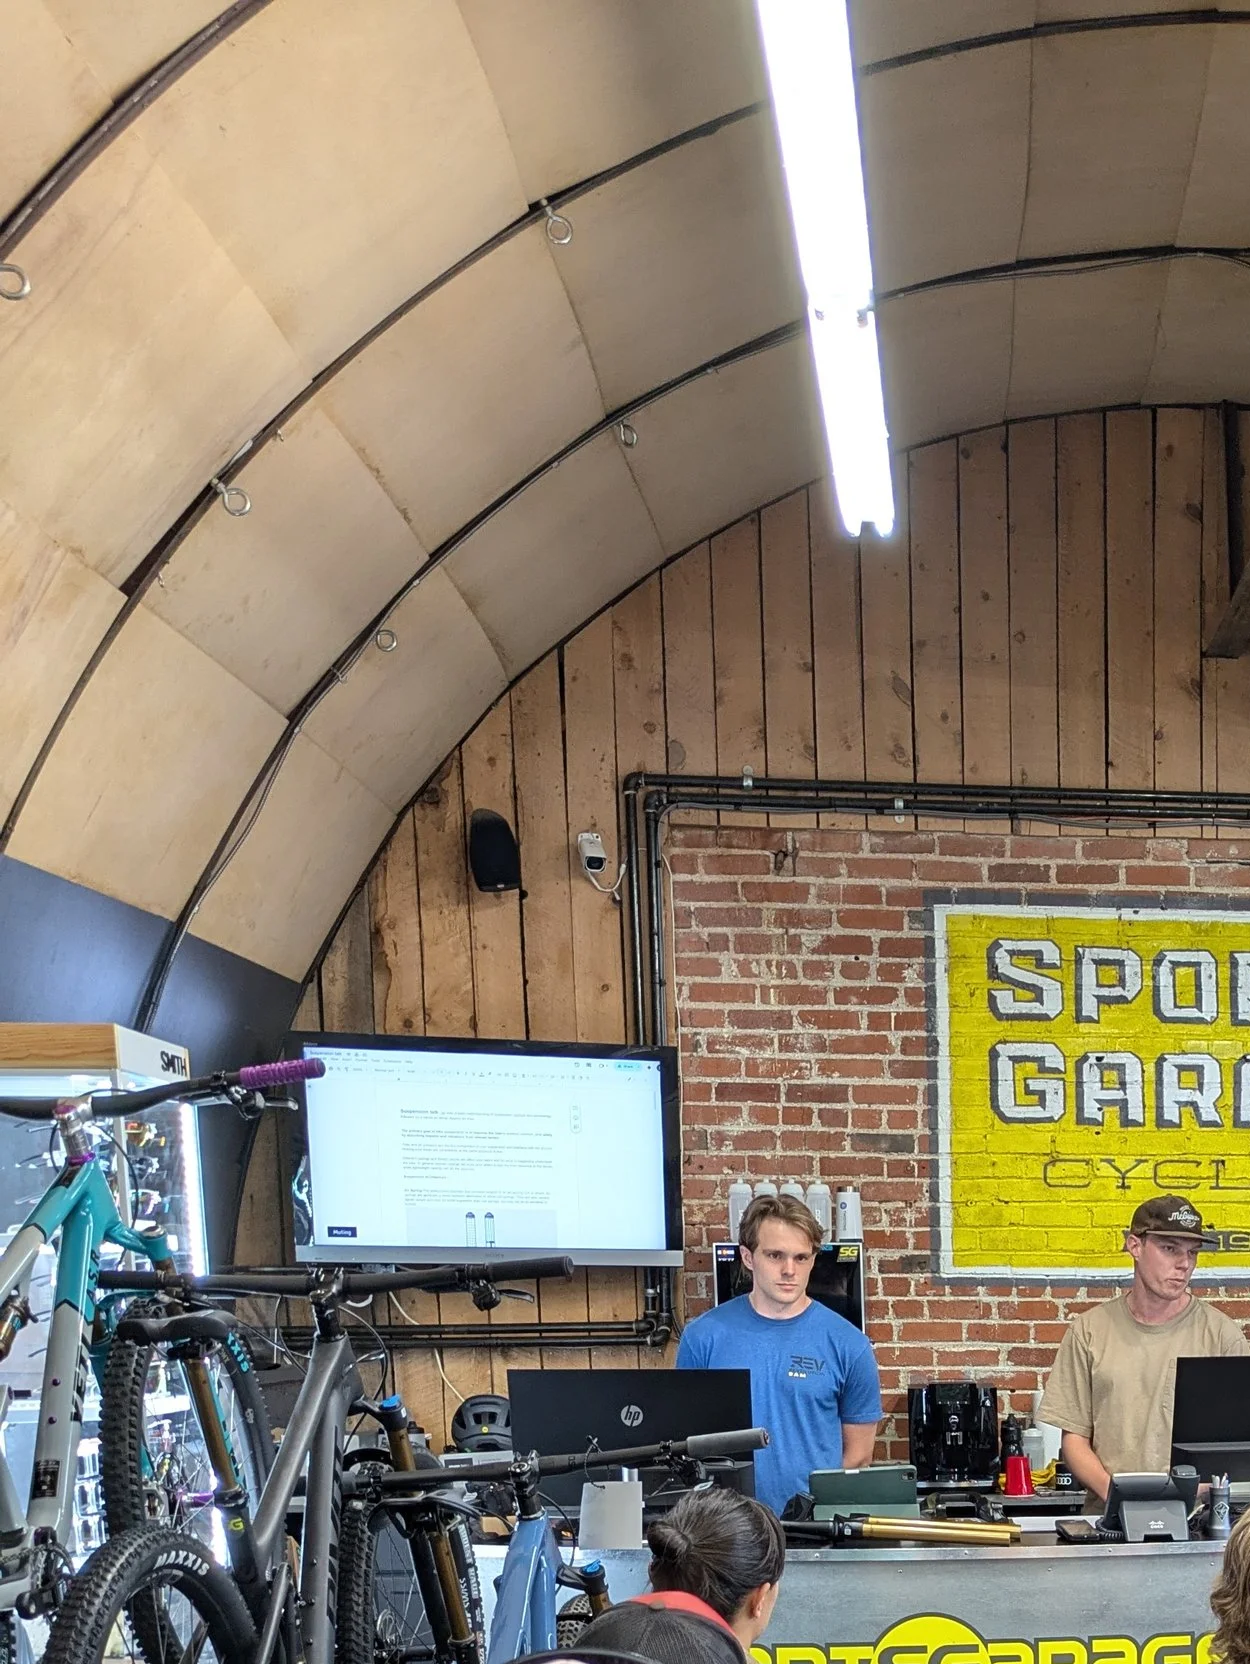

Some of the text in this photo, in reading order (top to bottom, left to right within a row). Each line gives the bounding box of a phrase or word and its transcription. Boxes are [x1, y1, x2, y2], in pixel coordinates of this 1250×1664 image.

[160, 1051, 188, 1076] SMITH
[332, 1228, 353, 1238] Muting
[839, 1246, 859, 1257] SG
[620, 1404, 644, 1427] hp
[153, 1550, 211, 1576] MAXXIS
